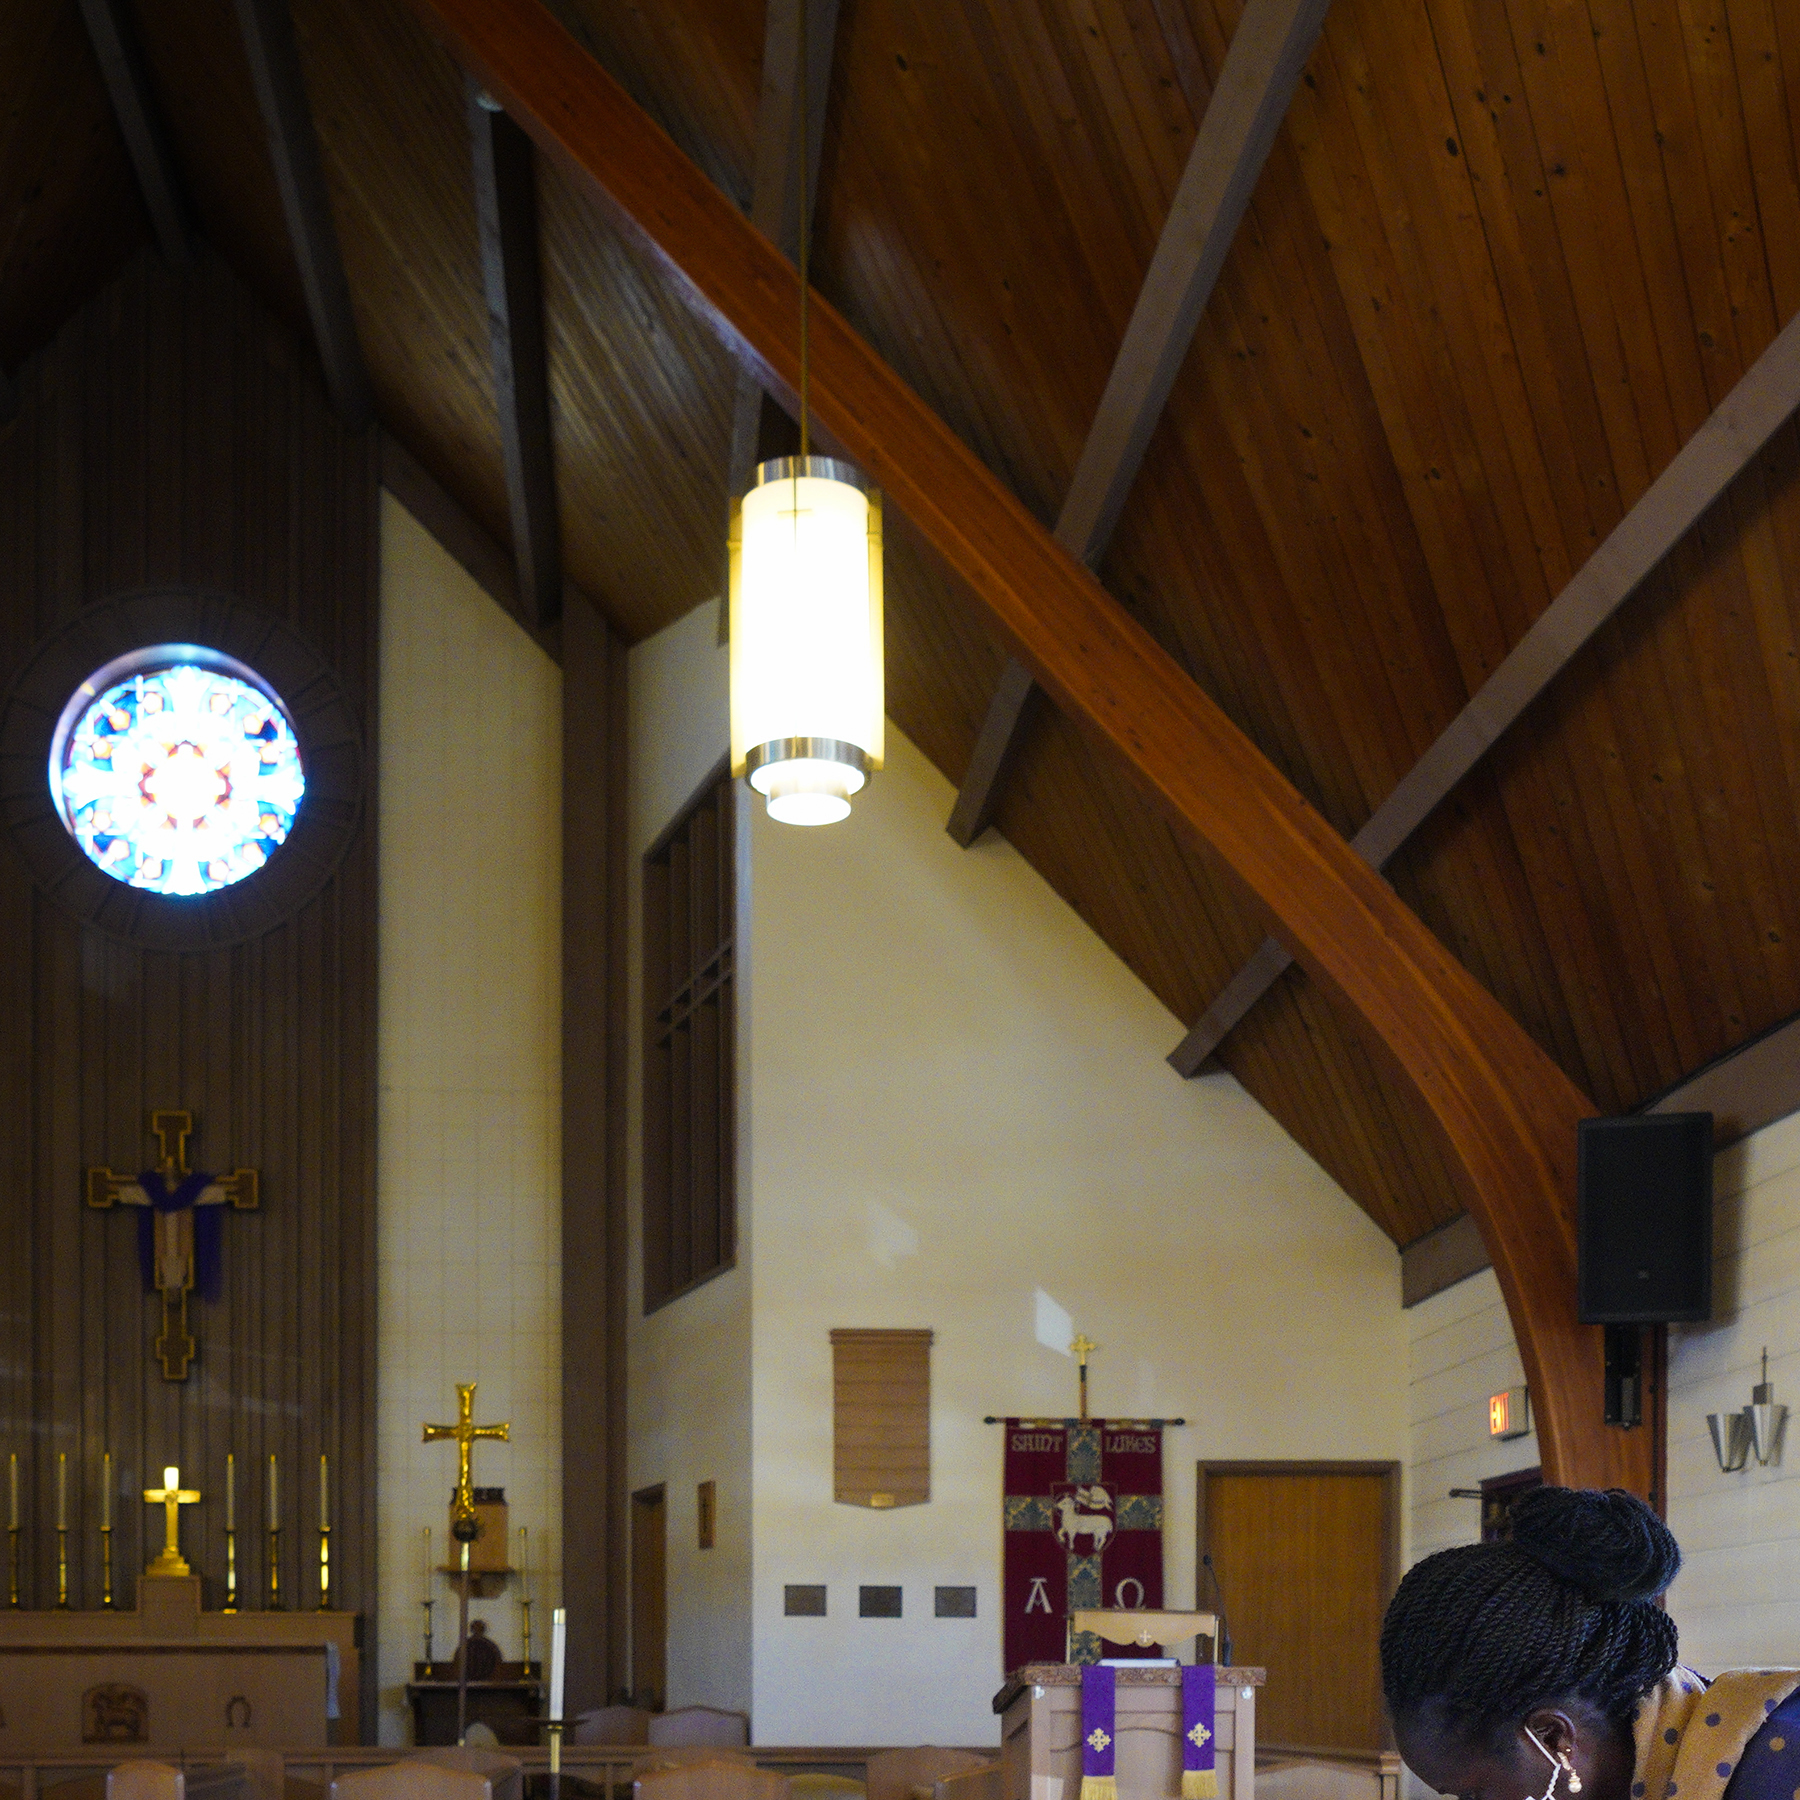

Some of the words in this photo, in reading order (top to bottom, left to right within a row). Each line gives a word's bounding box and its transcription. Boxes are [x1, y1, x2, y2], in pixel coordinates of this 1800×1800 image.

[1490, 1392, 1509, 1435] EXIT
[1011, 1433, 1063, 1453] SAINT
[1106, 1435, 1157, 1454] LUKES
